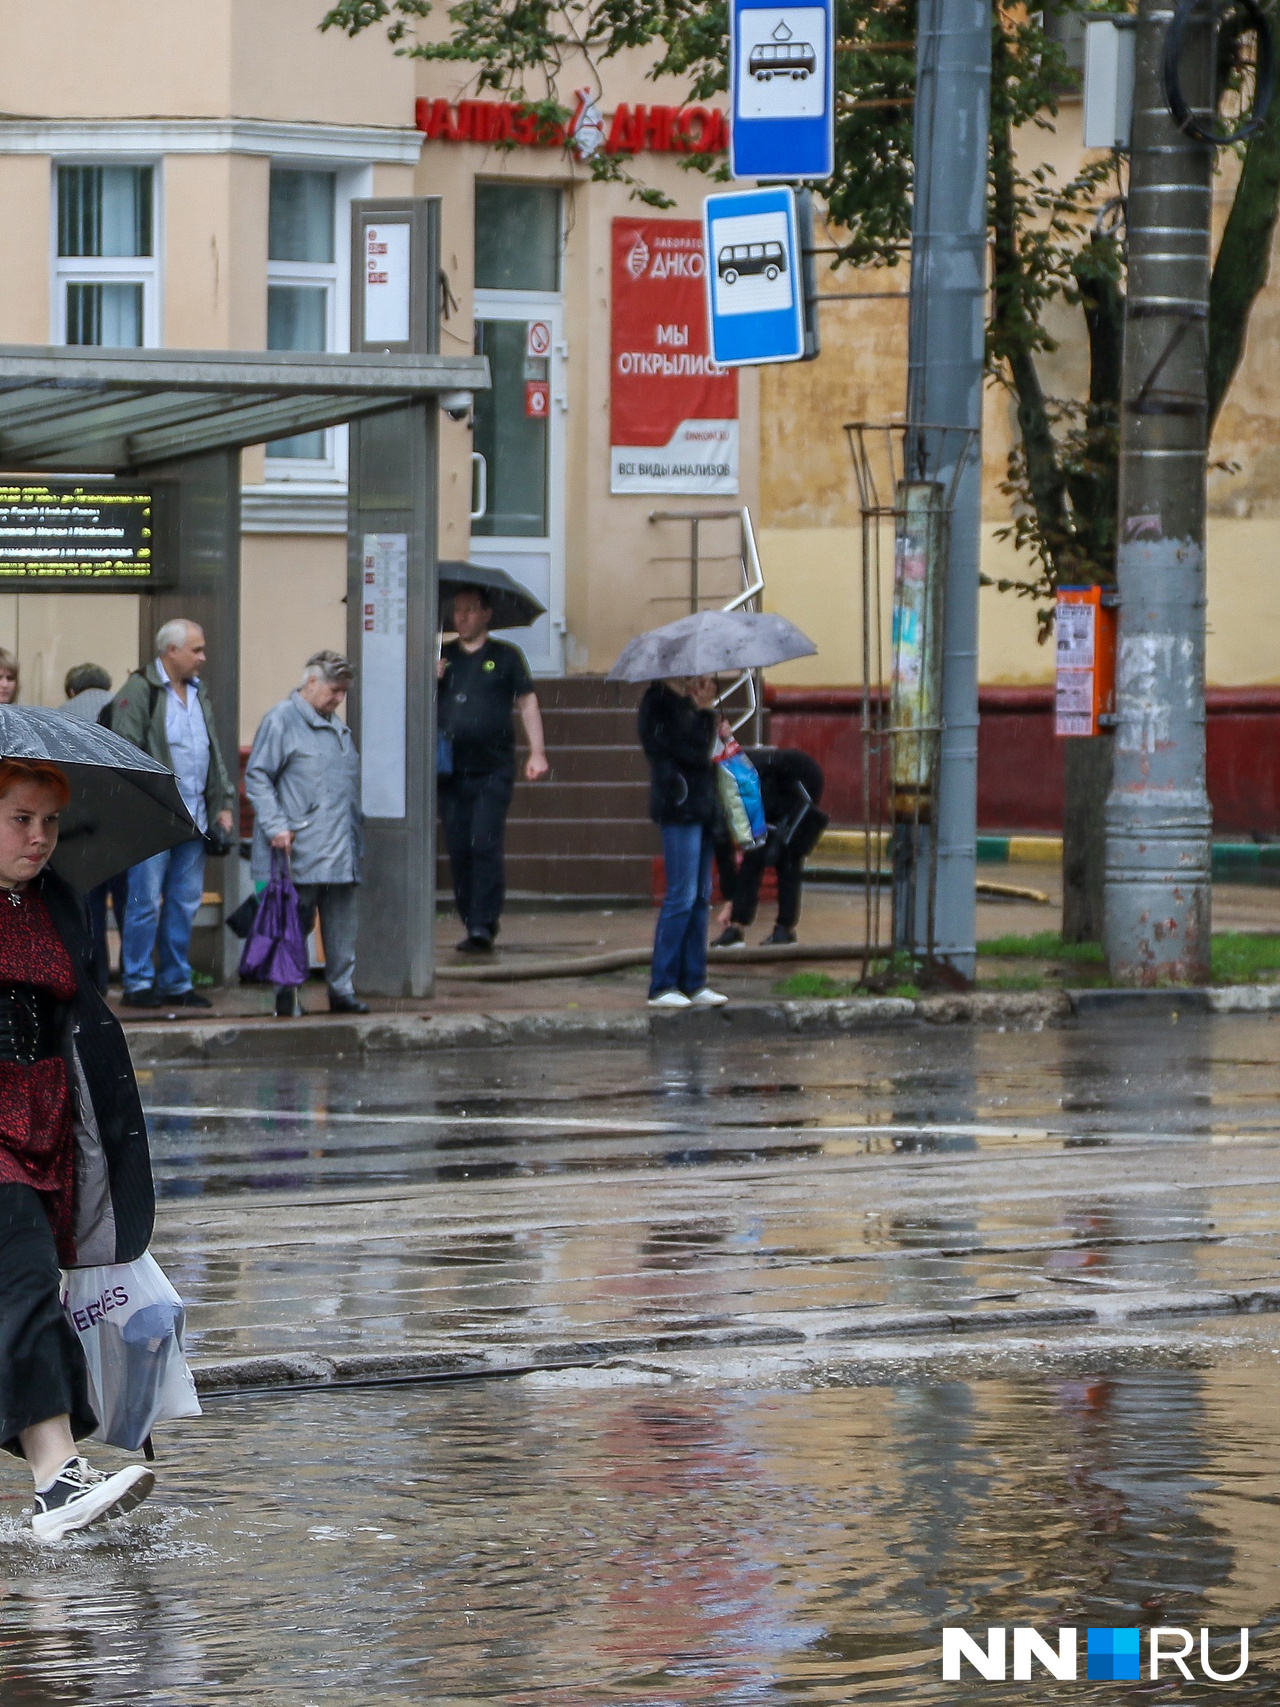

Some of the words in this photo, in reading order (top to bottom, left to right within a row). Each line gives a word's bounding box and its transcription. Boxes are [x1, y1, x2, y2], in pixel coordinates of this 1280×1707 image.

[653, 236, 704, 249] ЛАБОРАТО
[650, 251, 705, 279] ДНКО
[656, 324, 690, 346] МЫ
[619, 352, 730, 376] ОТКРЫЛИС
[619, 462, 637, 476] ВСЕ
[639, 463, 670, 478] ВИДЫ
[672, 463, 730, 477] АНАЛИЗОВ
